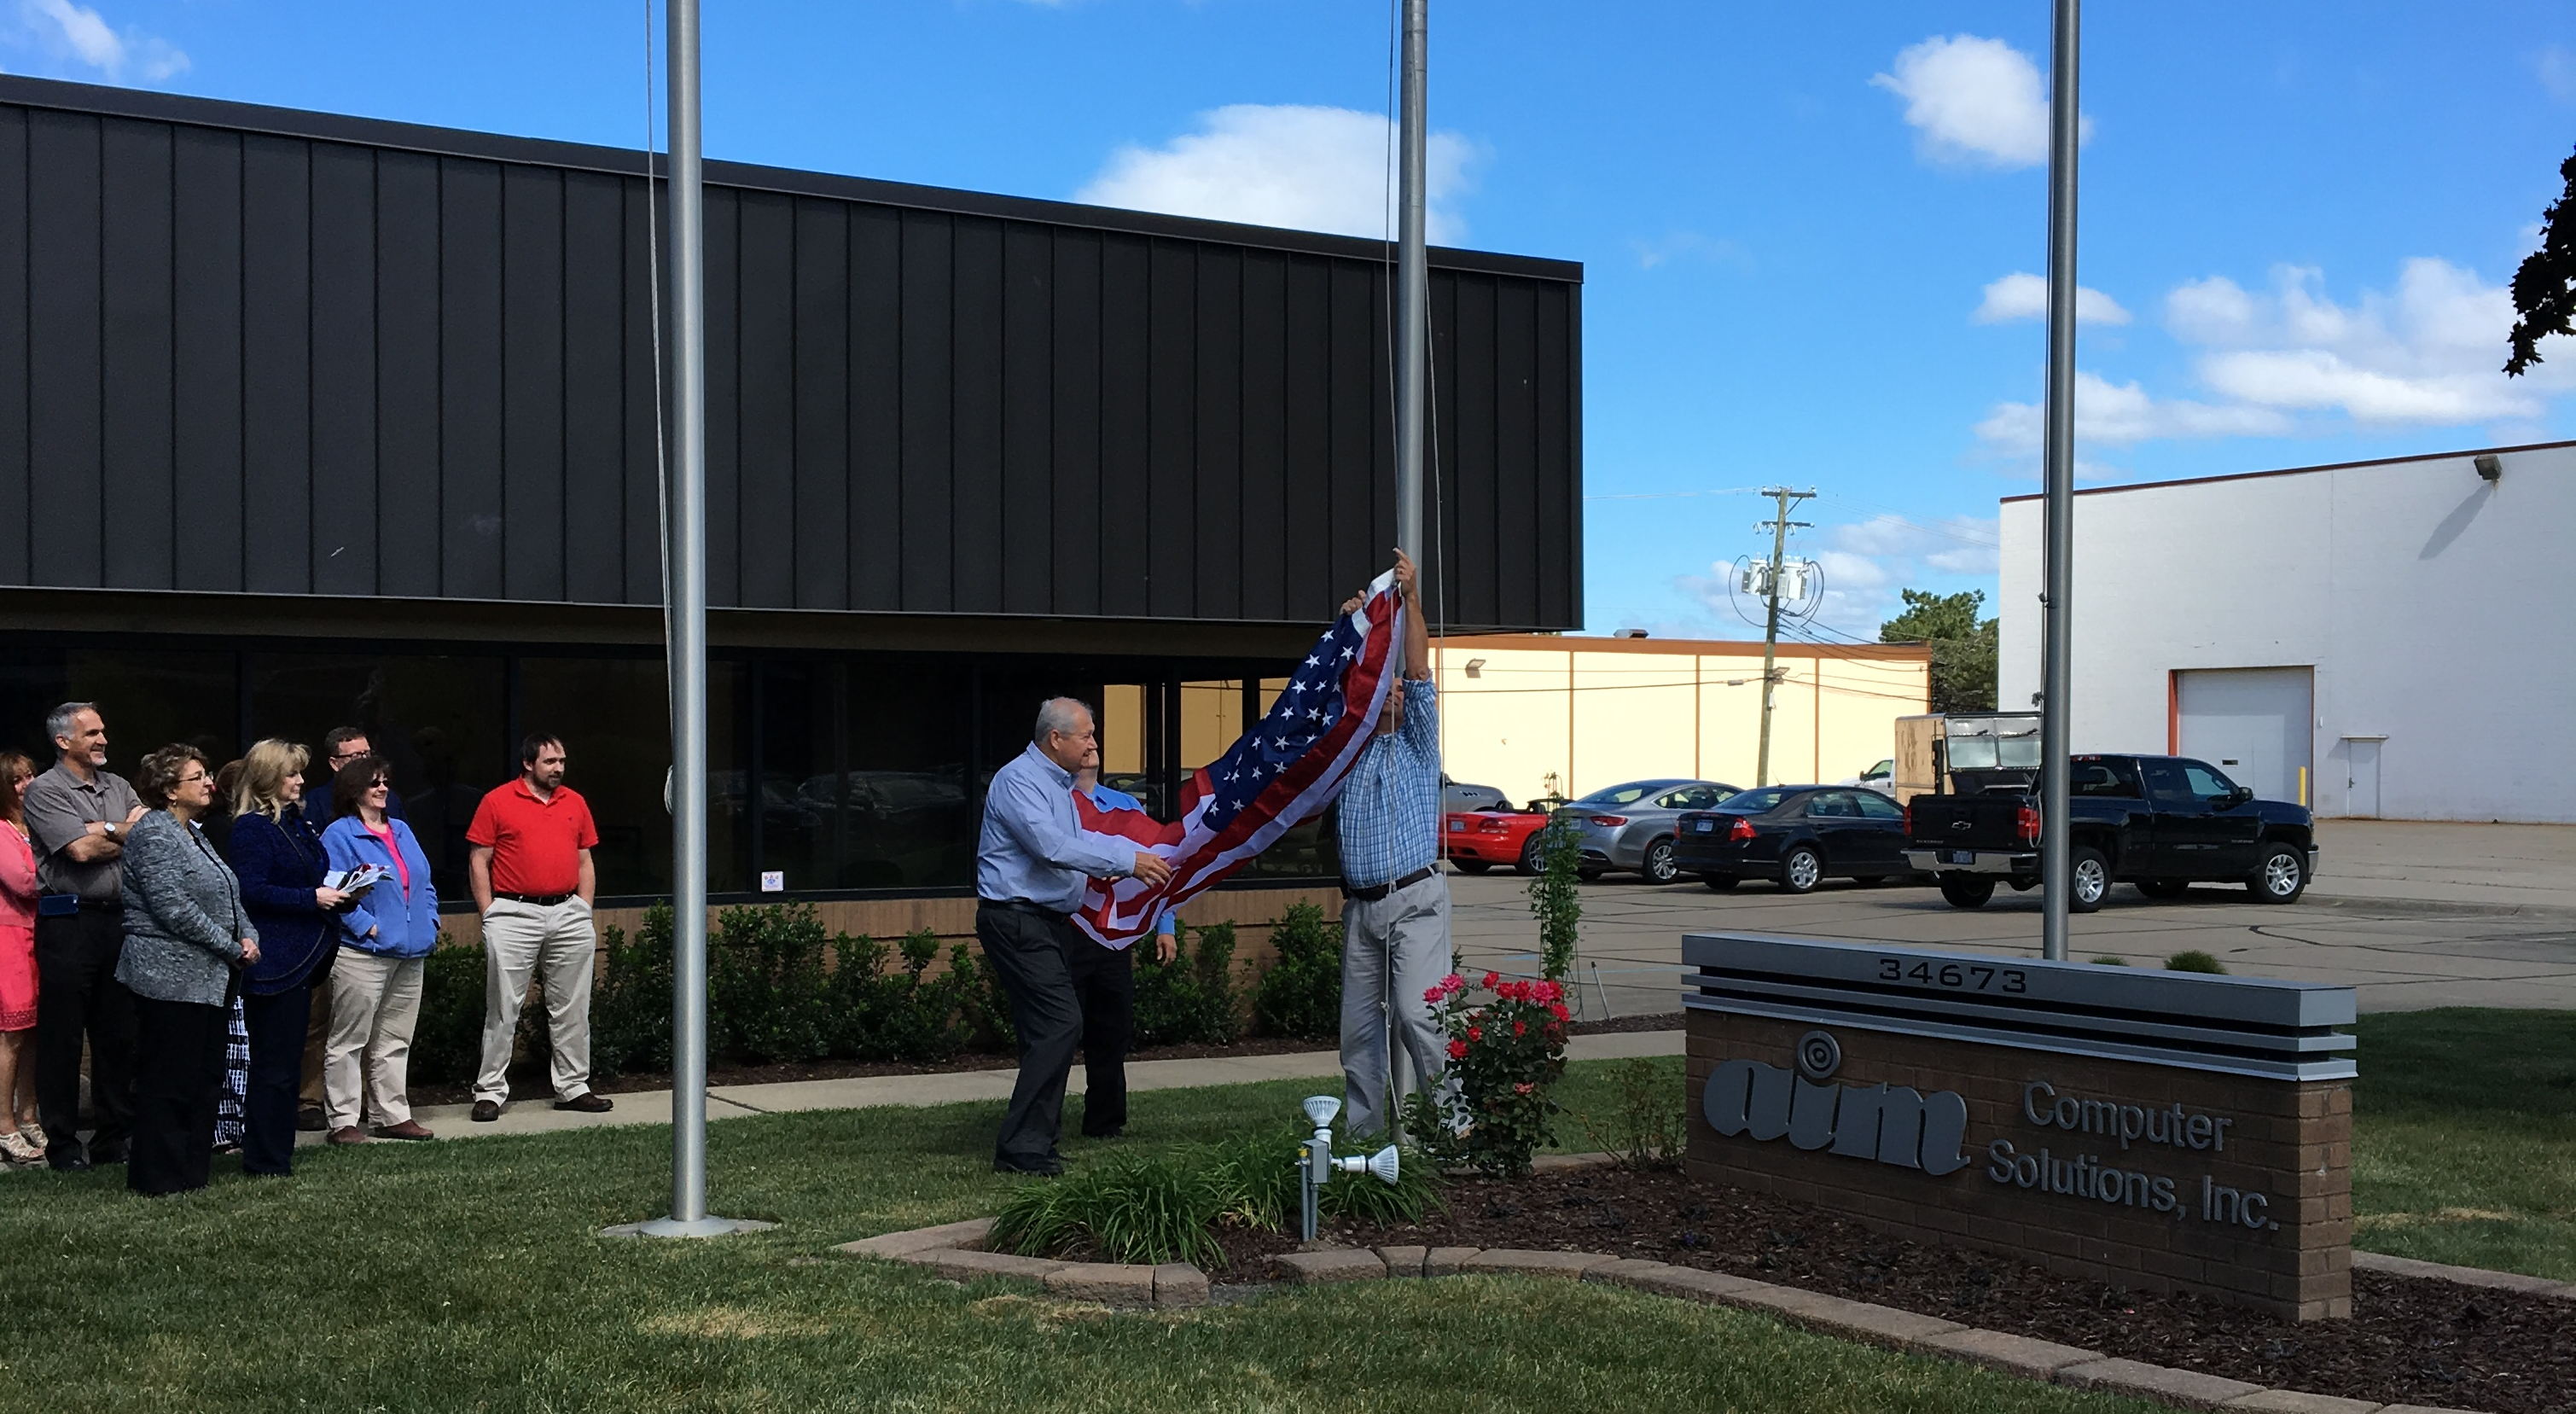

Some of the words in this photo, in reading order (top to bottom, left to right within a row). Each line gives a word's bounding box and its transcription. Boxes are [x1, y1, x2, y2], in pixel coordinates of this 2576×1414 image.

[1879, 958, 2027, 994] 34673
[1704, 1032, 1970, 1176] aim
[2023, 1080, 2232, 1152] Computer
[1988, 1138, 2187, 1221] Solutions,
[2201, 1174, 2279, 1231] Inc.
